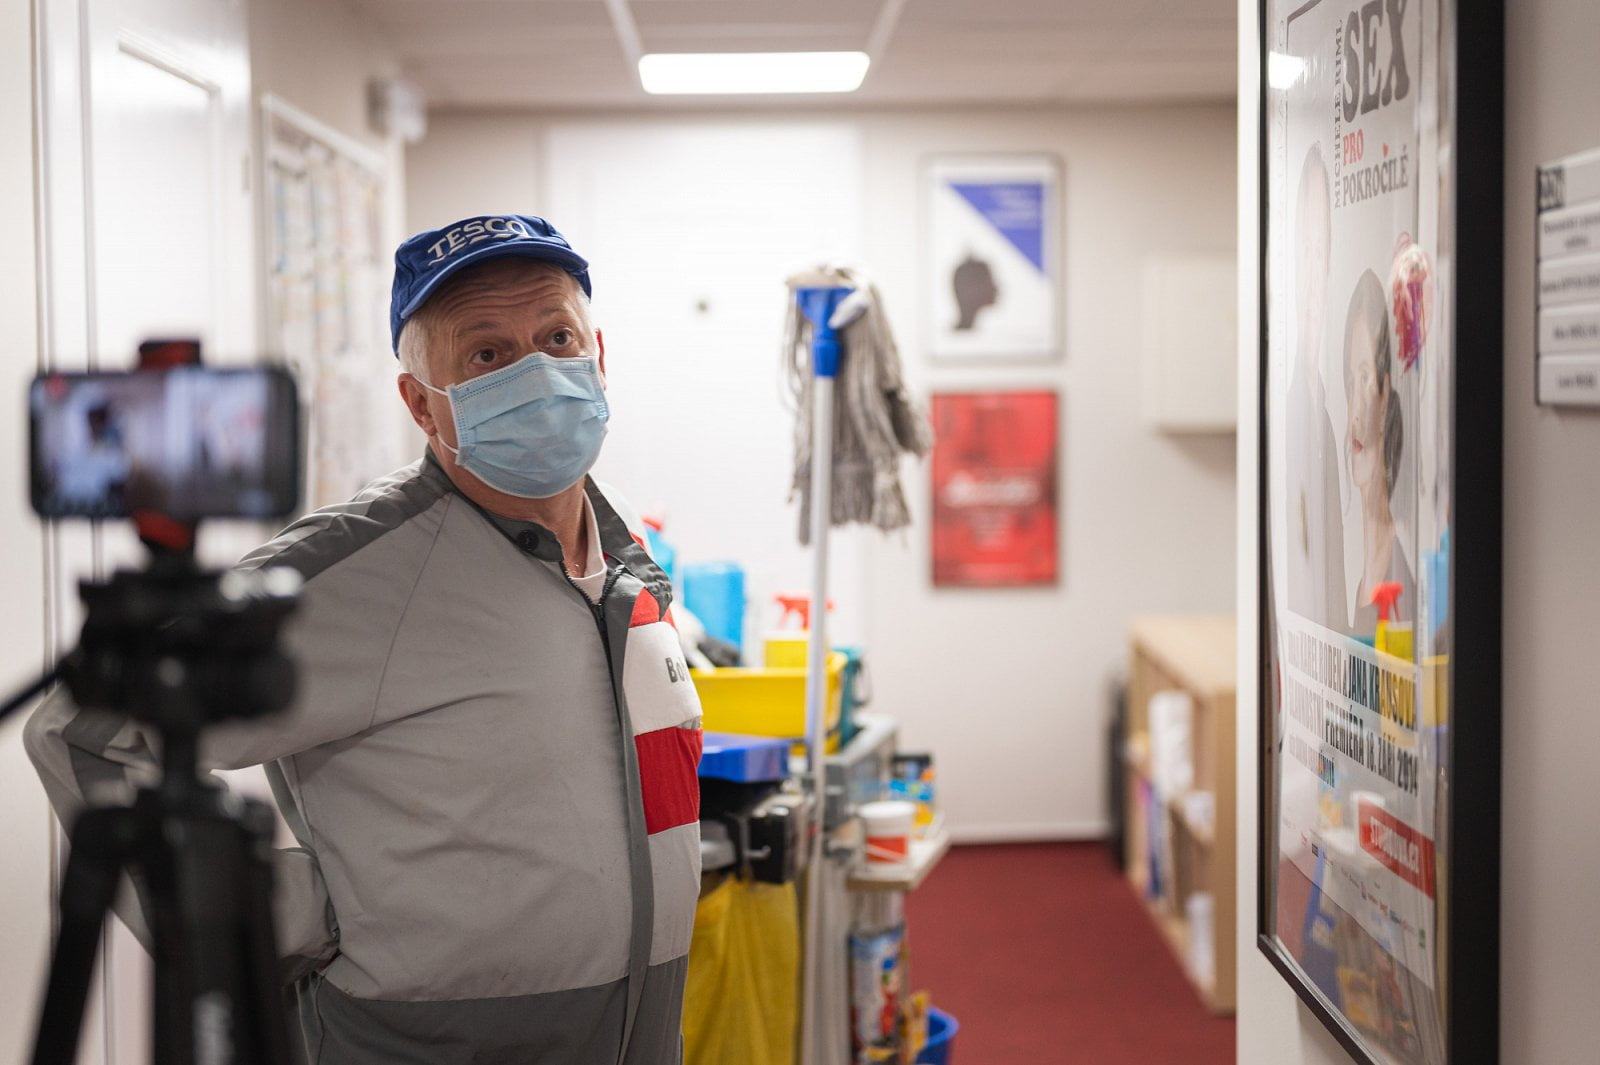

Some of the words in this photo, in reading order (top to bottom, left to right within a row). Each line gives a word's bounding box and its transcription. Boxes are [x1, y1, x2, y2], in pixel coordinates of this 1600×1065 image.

[1343, 0, 1410, 123] SEX
[1343, 128, 1364, 166] PRO
[1343, 143, 1409, 207] POKROČILÉ
[427, 218, 529, 258] TESCO
[1348, 653, 1368, 708] JANA
